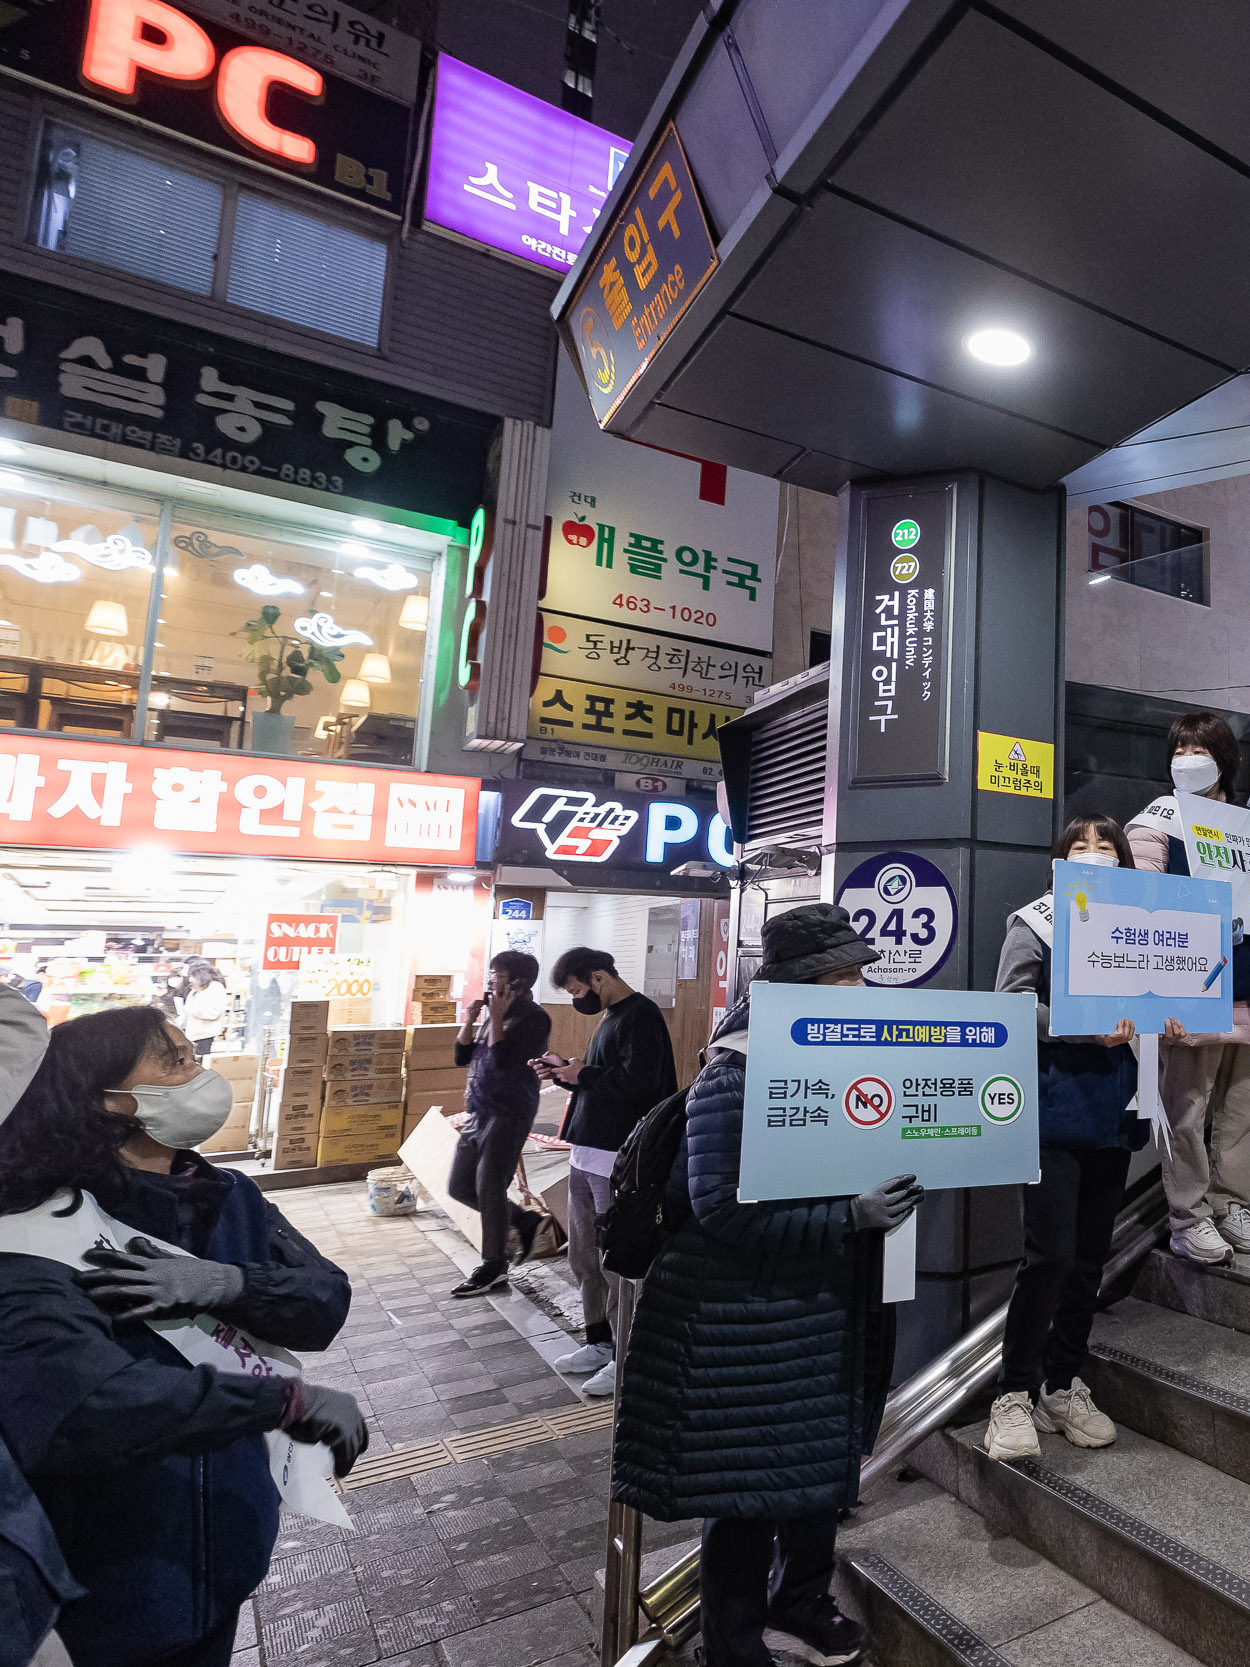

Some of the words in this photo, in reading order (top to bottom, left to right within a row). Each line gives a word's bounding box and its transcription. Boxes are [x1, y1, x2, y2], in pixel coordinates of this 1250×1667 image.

[82, 0, 323, 164] PC
[334, 153, 392, 200] B1
[599, 161, 683, 331] 출입구
[631, 264, 685, 351] Entrance
[62, 410, 183, 458] 건대역점
[189, 442, 345, 493] 3409-8833
[568, 490, 597, 509] 건대
[895, 527, 917, 541] 212
[894, 561, 916, 575] 727
[611, 593, 717, 628] 463-1020
[906, 589, 919, 636] Konkuk
[578, 632, 766, 689] 동방경희한의원
[868, 590, 900, 733] 건대입구
[905, 637, 918, 670] Univ.
[668, 681, 733, 701] 499-1275
[539, 689, 654, 739] 스포츠
[539, 726, 555, 736] B1
[640, 778, 663, 792] B1
[990, 774, 1043, 793] 미끄럼주의
[151, 766, 376, 842] 할인점
[1224, 832, 1245, 846] 인파가
[269, 921, 334, 939] SNACK
[851, 907, 937, 947] 243
[1110, 926, 1149, 946] 수험생
[1152, 929, 1189, 949] 여러분
[874, 949, 922, 964] 차산로
[1087, 951, 1150, 971] 수능보느라
[1152, 954, 1209, 973] 고생했어요
[866, 965, 917, 974] Achasan-ro
[324, 977, 372, 998] 2000
[806, 1023, 876, 1042] 빙결도로
[881, 1024, 962, 1043] 사고예방을
[965, 1026, 996, 1044] 위해
[767, 1078, 836, 1100] 급가속,
[902, 1077, 974, 1098] 안전용품
[854, 1092, 884, 1110] NO
[987, 1091, 1015, 1106] YES
[766, 1105, 830, 1128] 급감속
[901, 1103, 938, 1124] 구비
